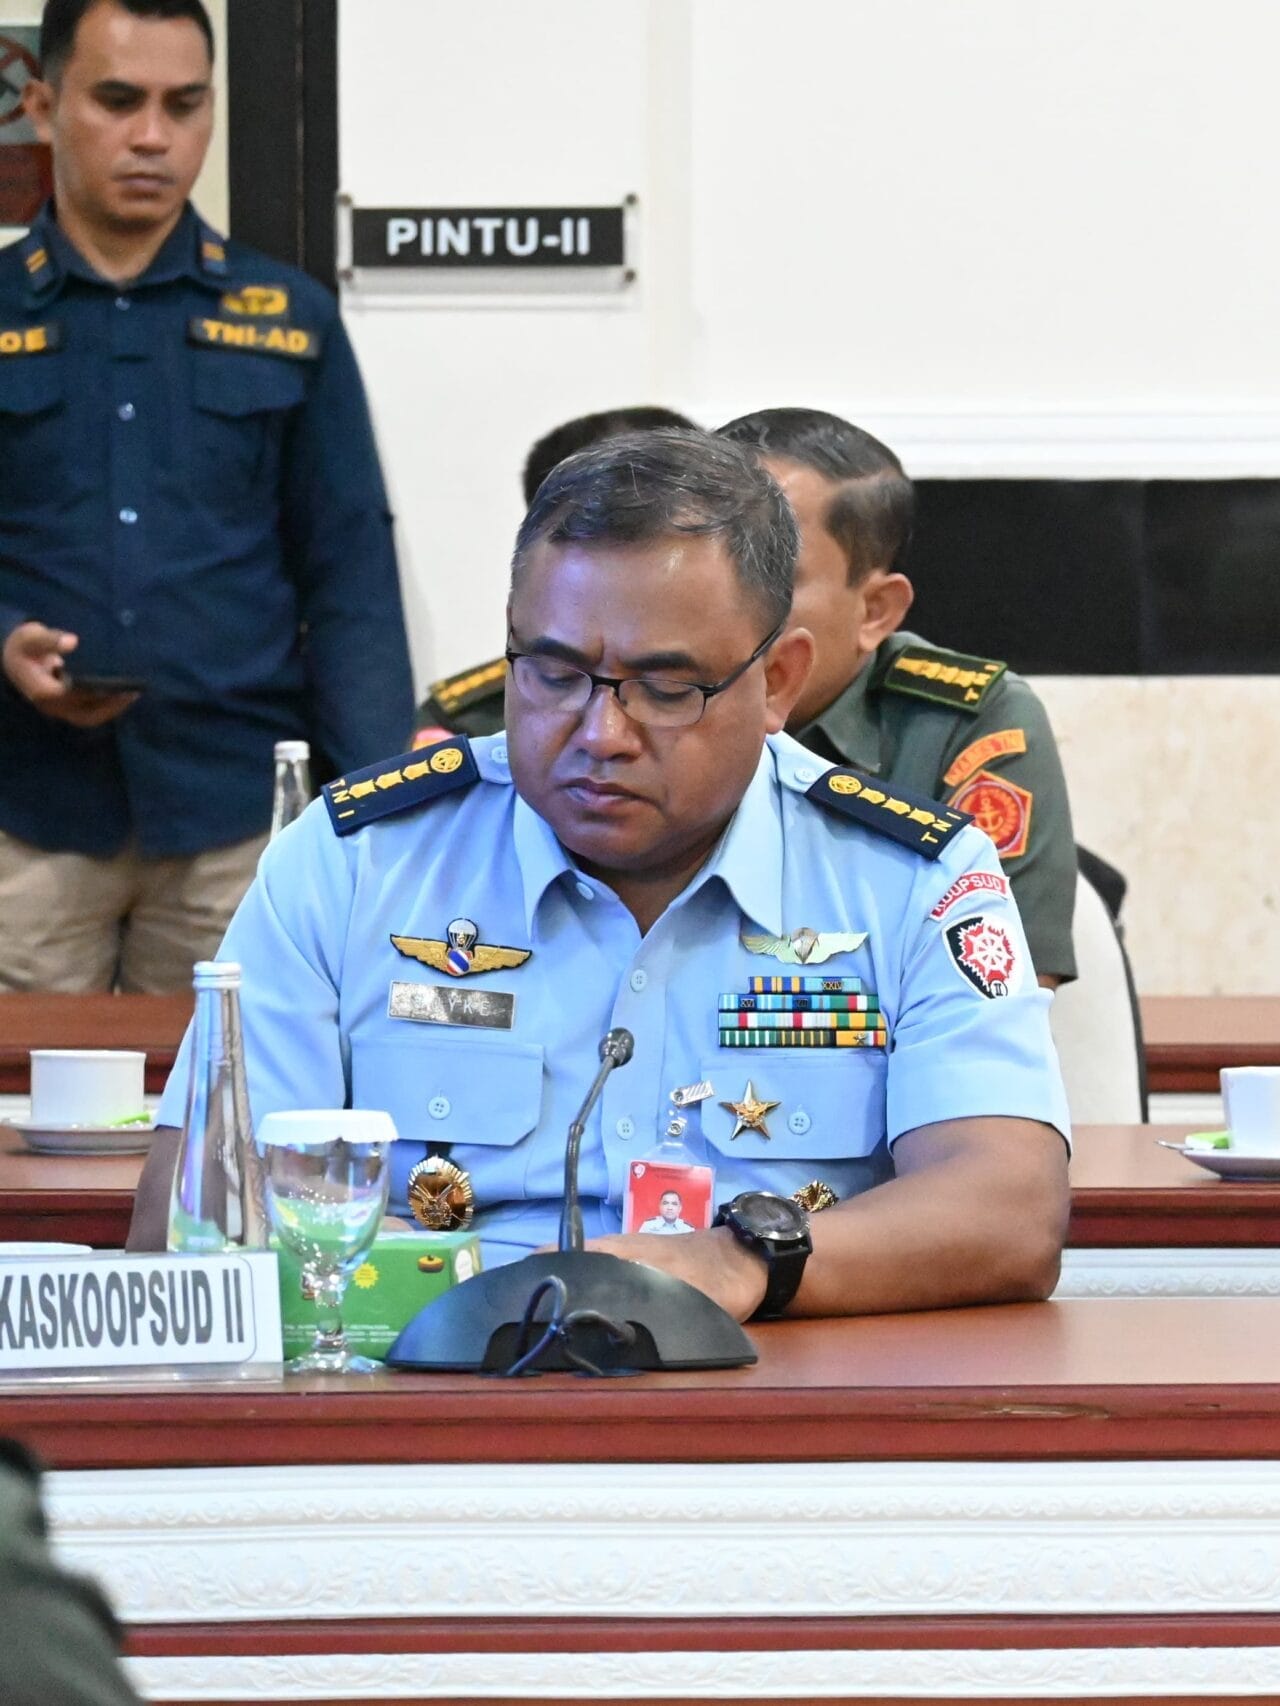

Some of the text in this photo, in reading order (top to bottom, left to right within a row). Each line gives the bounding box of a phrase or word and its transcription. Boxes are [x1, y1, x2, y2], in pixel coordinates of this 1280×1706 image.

[386, 217, 590, 256] PINTU-II
[202, 319, 309, 354] TNI-AD
[329, 778, 355, 819] TNI
[921, 811, 962, 844] TNI
[0, 1268, 245, 1349] KASKOOPSUD II
